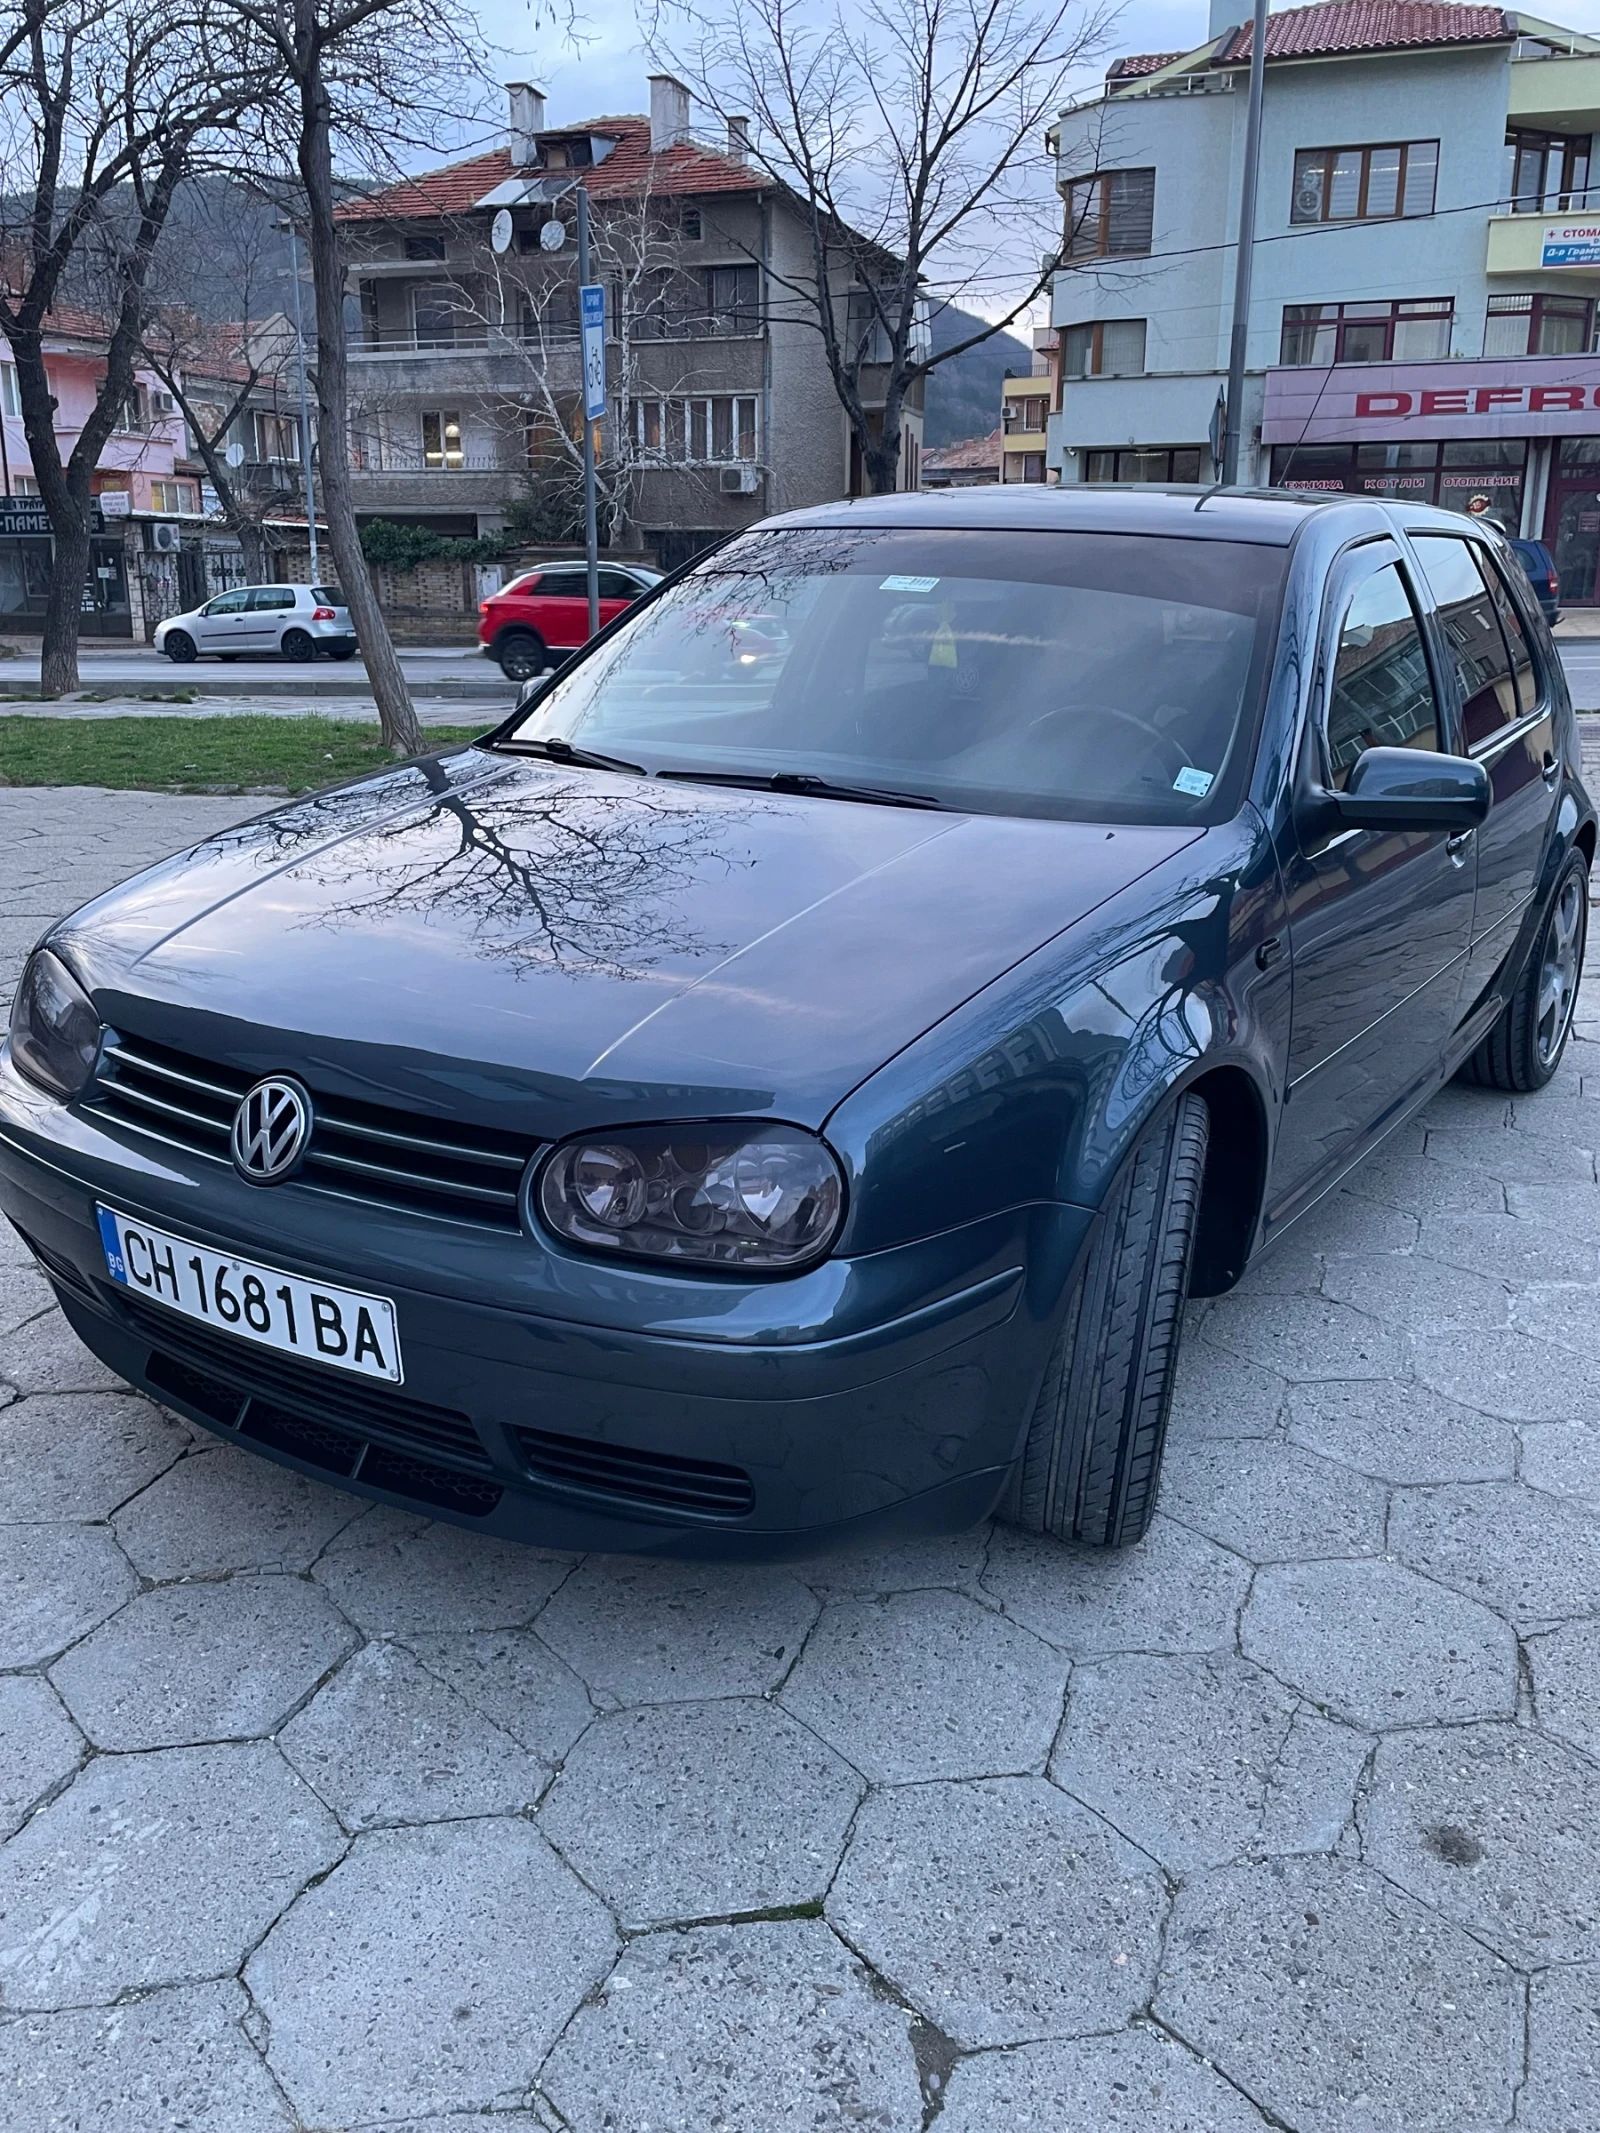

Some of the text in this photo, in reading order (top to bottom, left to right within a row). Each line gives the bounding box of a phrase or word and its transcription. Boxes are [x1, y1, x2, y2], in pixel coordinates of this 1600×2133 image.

[1355, 386, 1600, 417] DEFR
[1284, 475, 1520, 489] ЕХНИКА КОТЛИ ОТОПЛЕНИЕ
[107, 1251, 124, 1273] BG
[124, 1230, 387, 1370] CH 1681 BA
